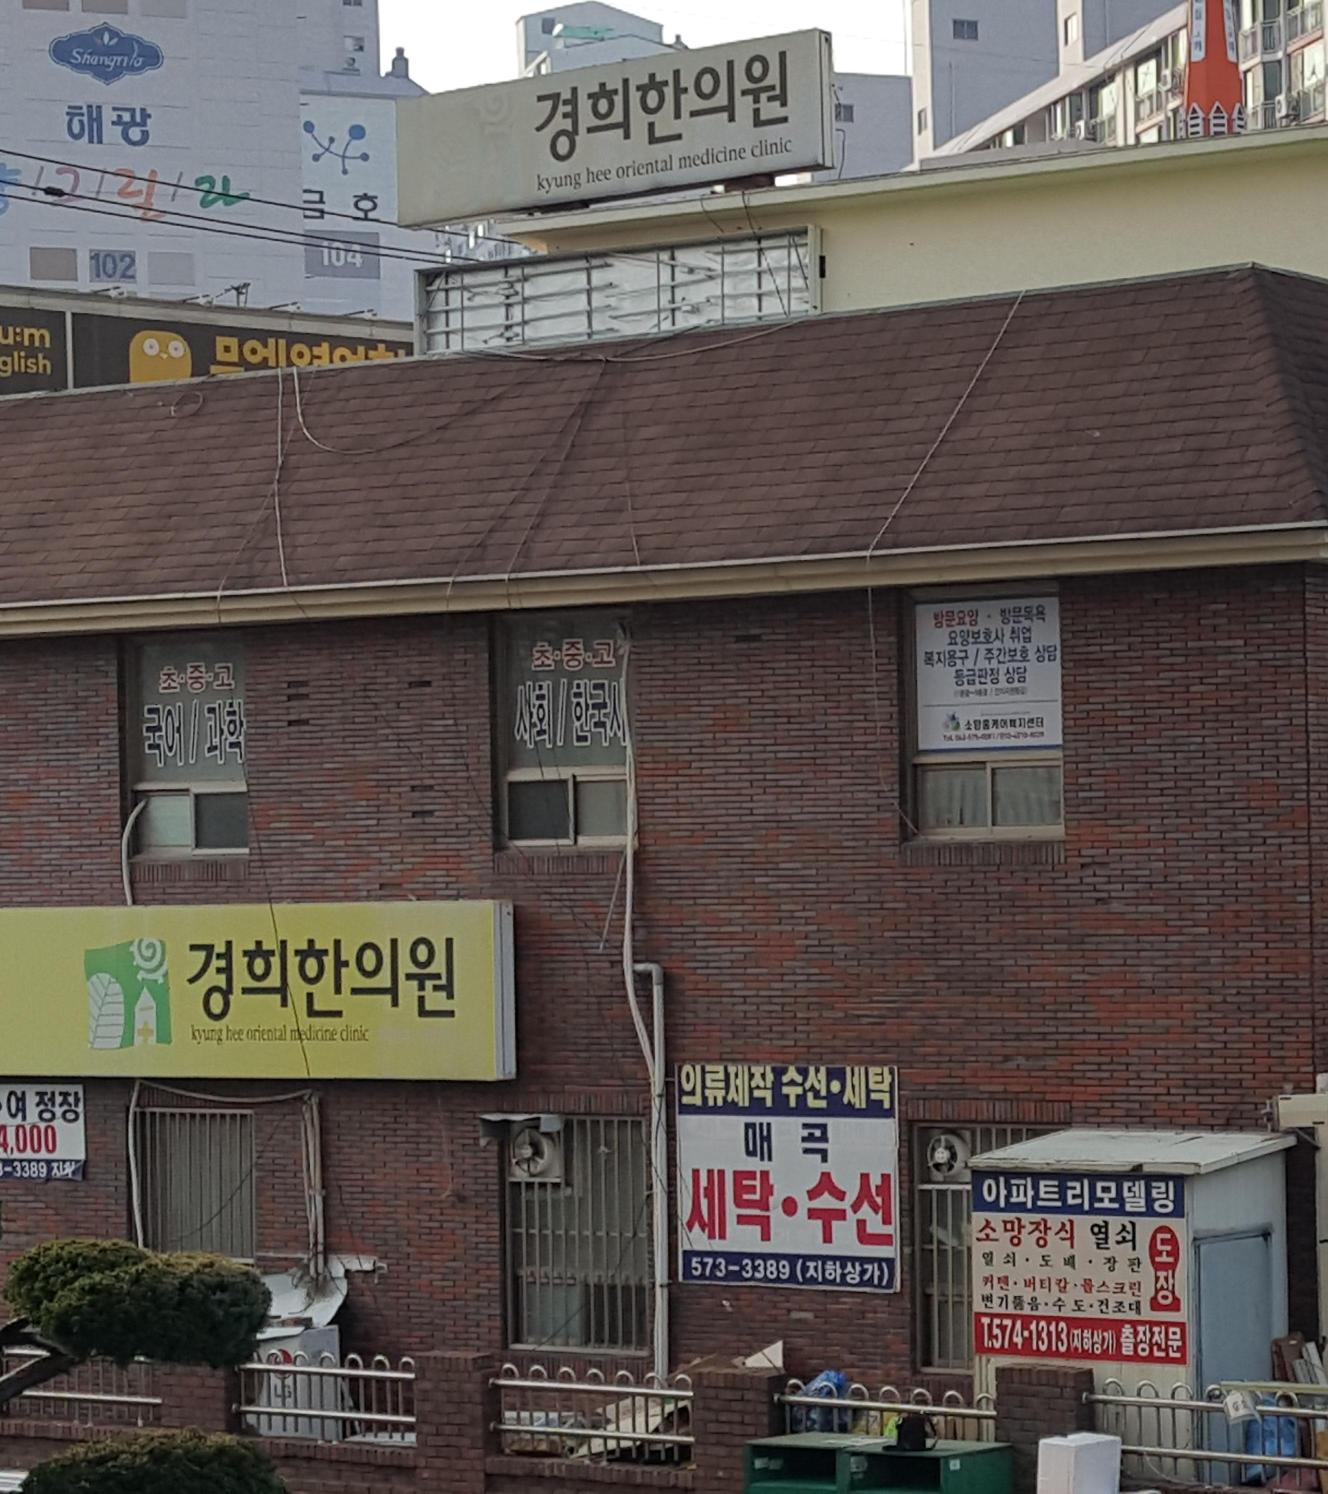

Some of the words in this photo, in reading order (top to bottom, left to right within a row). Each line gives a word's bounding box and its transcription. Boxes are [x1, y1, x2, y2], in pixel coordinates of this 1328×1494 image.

[534, 50, 789, 162] 경희한의원
[66, 104, 152, 147] 해광
[536, 173, 582, 194] kyung
[586, 166, 612, 183] hee
[615, 153, 673, 178] oriental
[678, 144, 746, 168] medicine
[751, 137, 793, 160] clinic
[90, 253, 136, 280] 102
[321, 241, 363, 268] 104
[933, 609, 979, 628] 방문요양
[947, 627, 1005, 646] 요양보호사
[1009, 626, 1032, 644] 취업
[924, 650, 969, 668] 복지용구
[984, 647, 1030, 664] 주간보호
[1035, 644, 1058, 663] 상담
[953, 667, 1000, 687] 등급판정
[1004, 665, 1027, 684] 상담
[186, 936, 456, 1022] 경희한의원
[191, 1025, 223, 1045] kyung
[225, 1025, 244, 1041] hee
[246, 1024, 287, 1041] oriental
[290, 1025, 338, 1042] medicine
[340, 1025, 369, 1042] clinic
[680, 1064, 774, 1108] 의류제작
[0, 1090, 27, 1122] 여
[35, 1091, 81, 1124] 정장
[982, 1176, 1175, 1214] 아파트리모델링
[975, 1216, 1075, 1249] 소망장식
[1090, 1220, 1137, 1252] 열쇠
[691, 1257, 790, 1280] 573-3389
[796, 1259, 889, 1286] (지하상가)
[980, 1317, 1068, 1352] T.574-1313
[1069, 1328, 1117, 1355] (지하상가)
[1120, 1324, 1182, 1358] 출장전문
